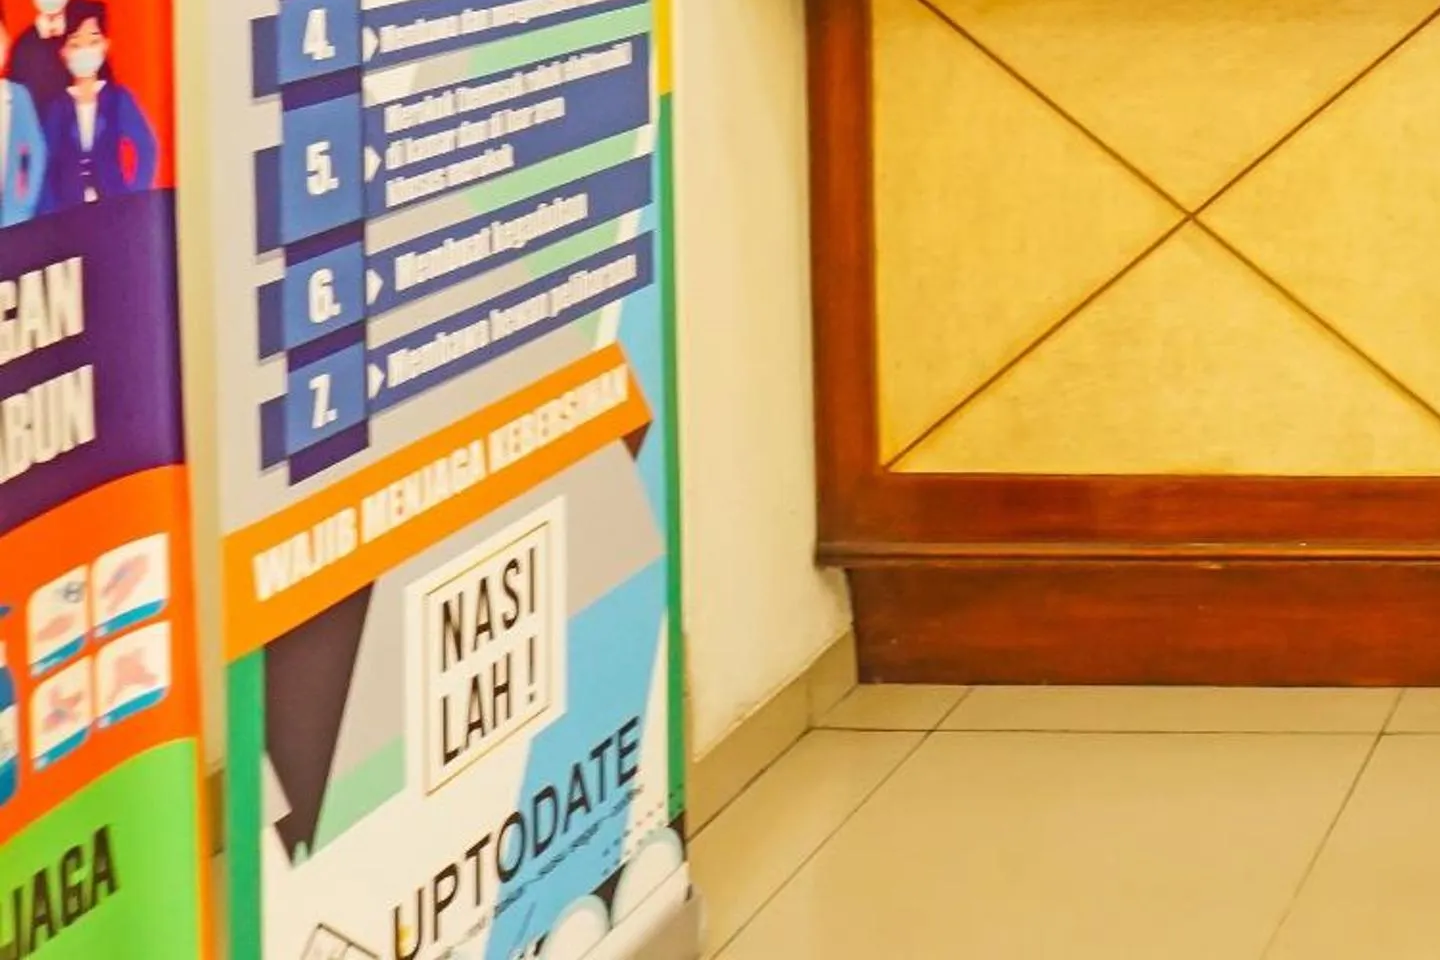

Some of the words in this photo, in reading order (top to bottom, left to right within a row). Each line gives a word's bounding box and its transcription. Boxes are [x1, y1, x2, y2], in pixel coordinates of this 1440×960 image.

[306, 141, 340, 196] 5.
[308, 267, 342, 324] 6.
[0, 363, 97, 484] BUN
[309, 374, 338, 429] 7.
[252, 506, 358, 603] WAJIB
[361, 438, 487, 545] MENJAGA
[440, 547, 537, 673] NASI
[391, 714, 642, 960] UPTODATE
